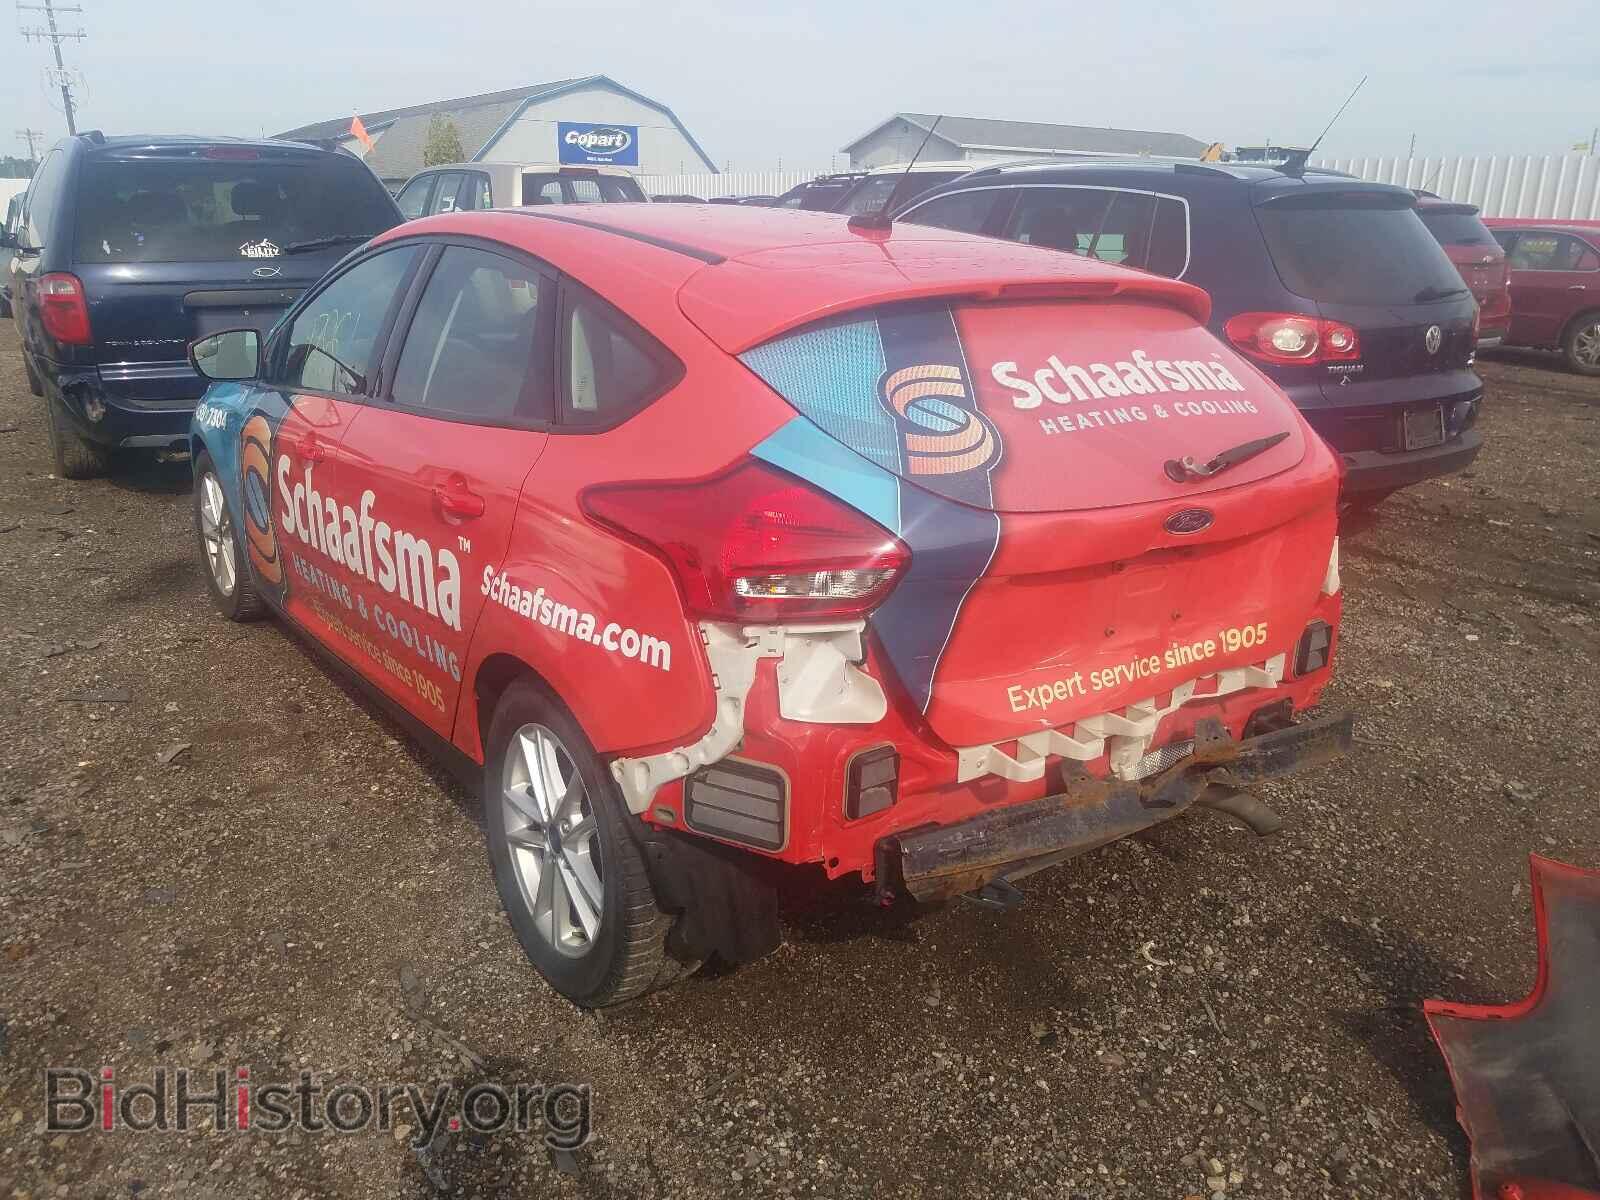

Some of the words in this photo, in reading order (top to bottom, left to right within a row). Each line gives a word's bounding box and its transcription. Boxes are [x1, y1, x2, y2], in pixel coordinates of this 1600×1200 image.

[565, 130, 624, 148] Copart
[991, 350, 1245, 409] Schaafsma
[1039, 406, 1148, 435] HEATING
[1153, 403, 1169, 418] &
[1174, 400, 1258, 416] COOLING
[278, 454, 462, 632] Schaafsma
[292, 551, 352, 609] HEATING
[358, 594, 369, 620] &
[374, 604, 461, 681] COOLING
[480, 564, 672, 672] Schaafsma.com
[412, 669, 445, 712] 1905
[1007, 671, 1086, 712] Expert
[1090, 655, 1161, 691] service
[1164, 638, 1216, 668] since
[1218, 622, 1268, 653] 1905
